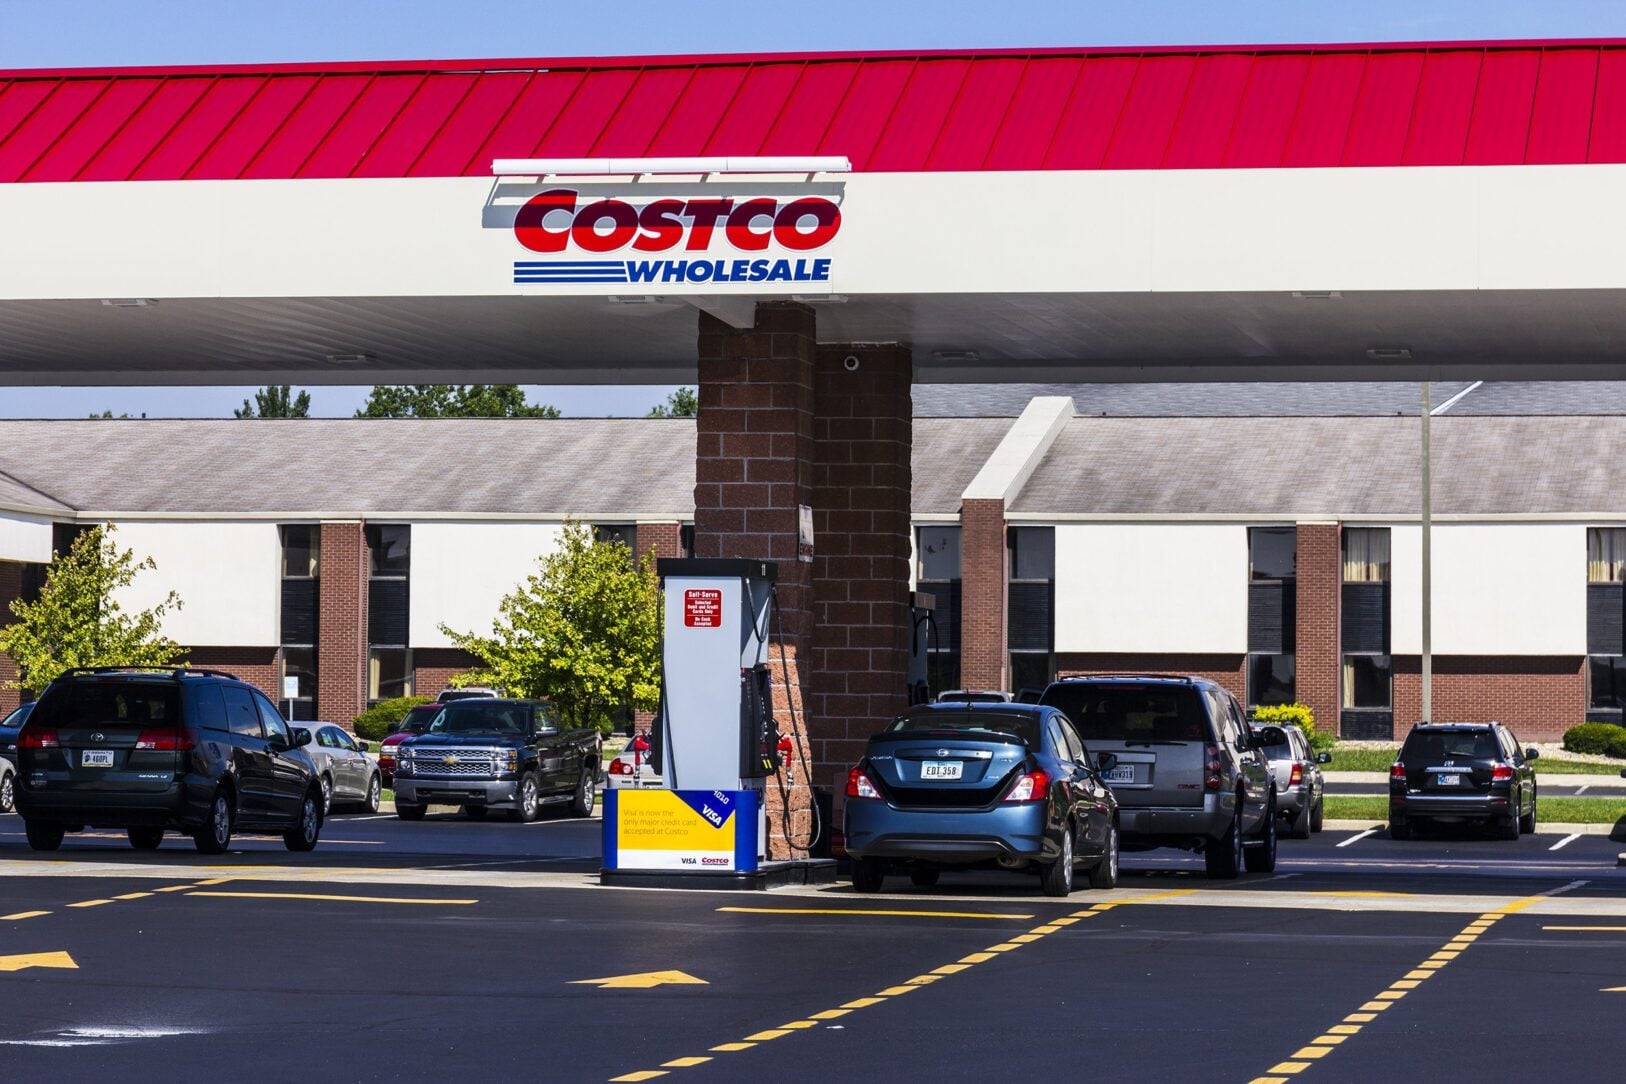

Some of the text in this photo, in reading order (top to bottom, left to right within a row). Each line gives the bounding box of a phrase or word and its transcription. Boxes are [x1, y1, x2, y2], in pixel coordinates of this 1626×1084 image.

[514, 188, 842, 252] COSTCO
[627, 258, 832, 282] WHOLESALE
[623, 818, 697, 827] only major credit card
[702, 803, 722, 826] VISA
[623, 827, 655, 836] accepted
[664, 827, 689, 835] Costco
